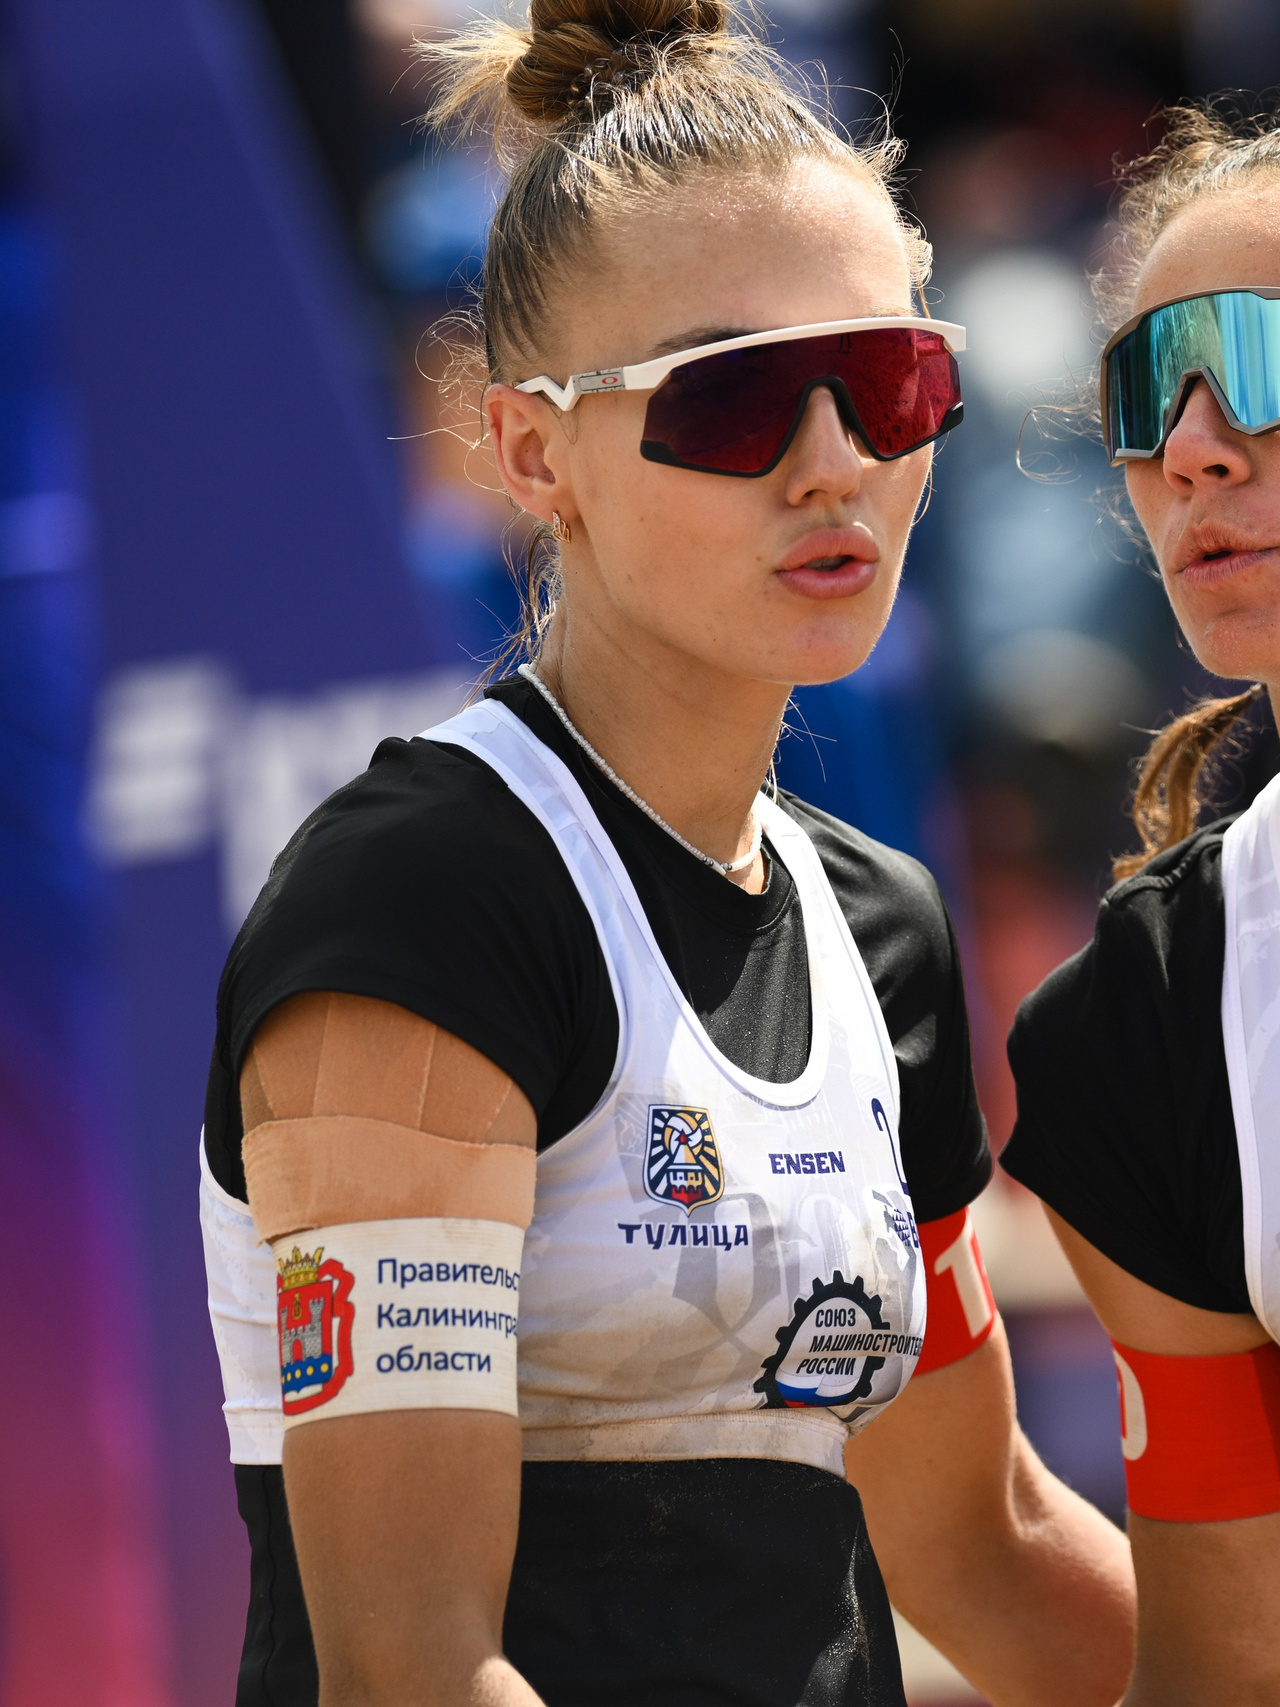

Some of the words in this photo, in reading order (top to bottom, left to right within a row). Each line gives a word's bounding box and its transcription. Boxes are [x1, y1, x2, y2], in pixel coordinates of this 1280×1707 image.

[768, 1151, 846, 1175] ENSEN
[617, 1222, 749, 1251] ТУЛИЦА
[815, 1308, 857, 1328] СОЮЗ
[376, 1344, 492, 1374] области
[796, 1357, 857, 1376] РОССИИ
